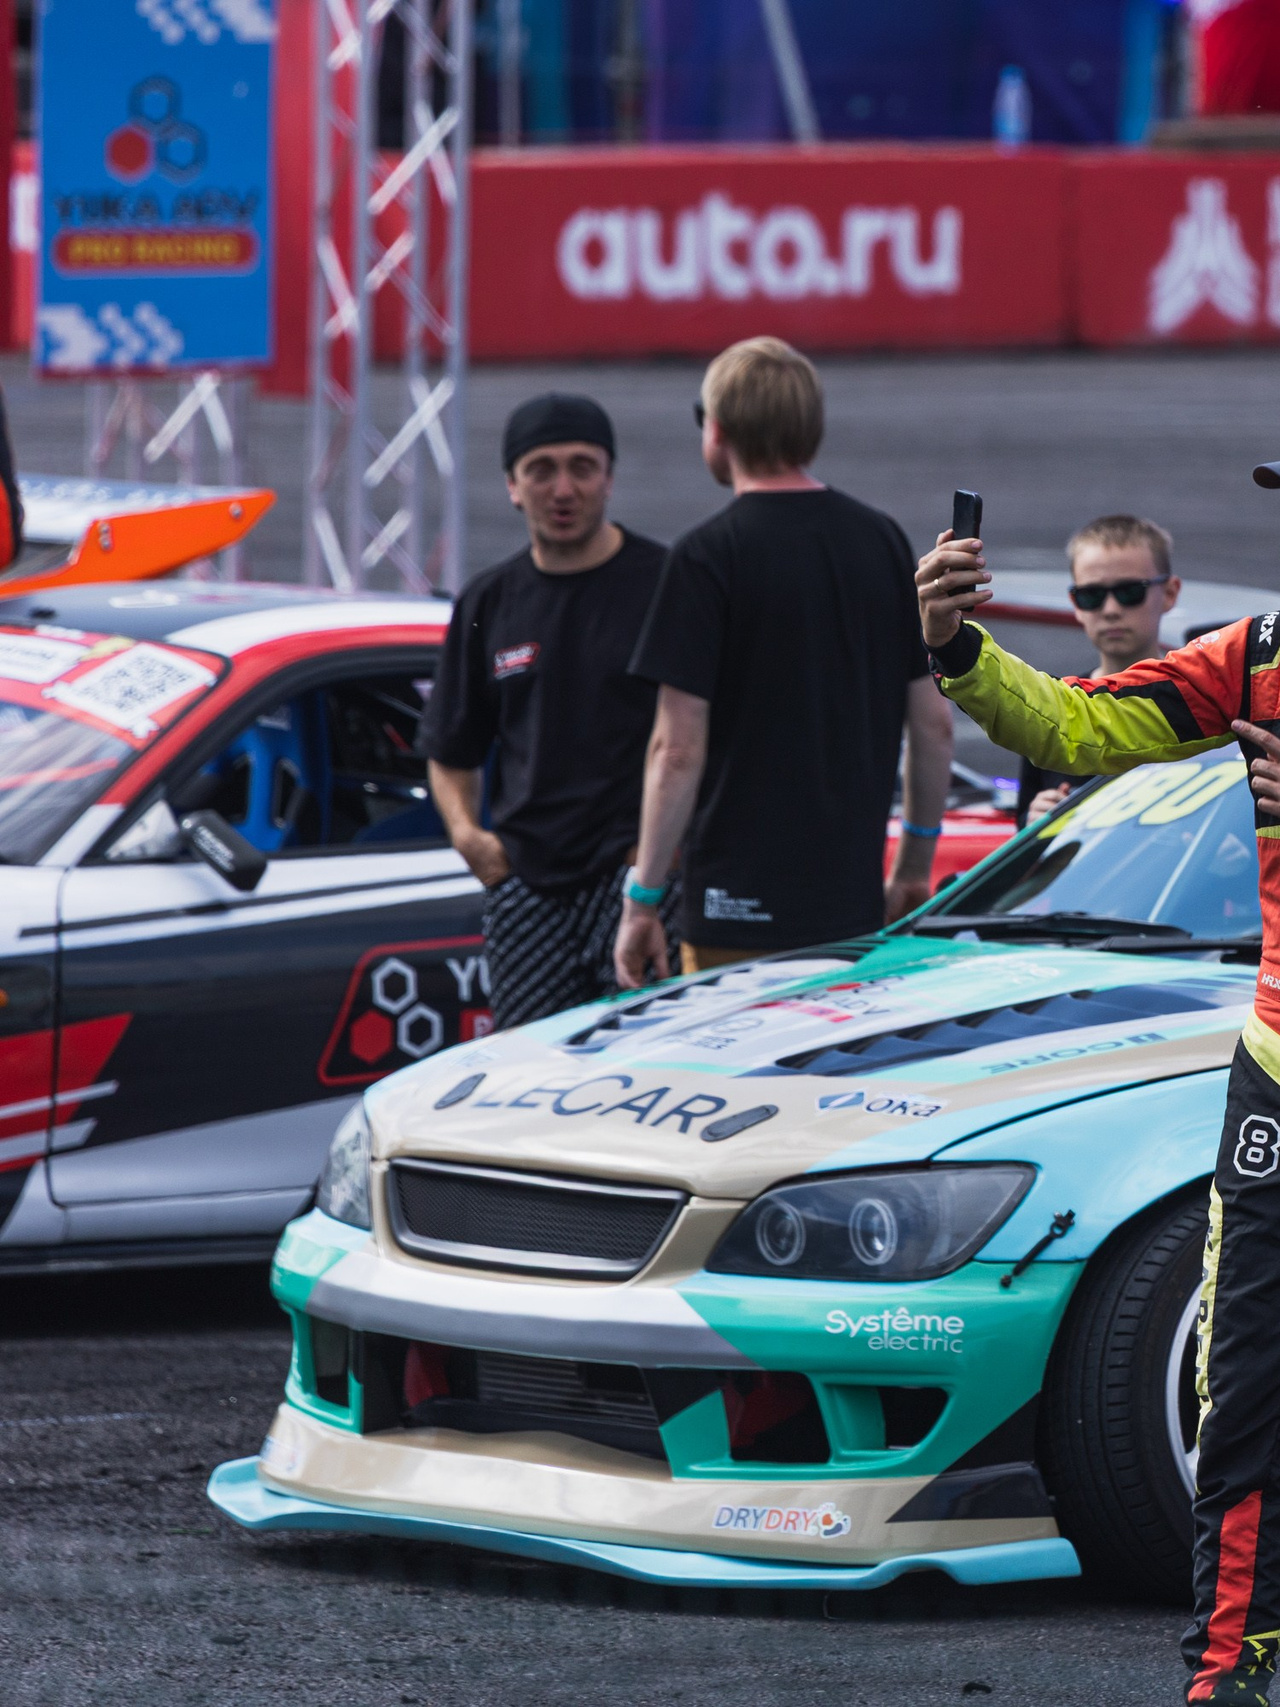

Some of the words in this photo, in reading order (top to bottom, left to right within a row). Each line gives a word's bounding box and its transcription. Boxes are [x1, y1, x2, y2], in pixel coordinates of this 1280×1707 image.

[557, 190, 961, 298] auto.ru
[1258, 611, 1280, 646] HRX
[471, 1073, 728, 1134] LECAR
[824, 1307, 965, 1338] Systême
[867, 1332, 964, 1354] electric
[715, 1506, 818, 1532] DRYDRY
